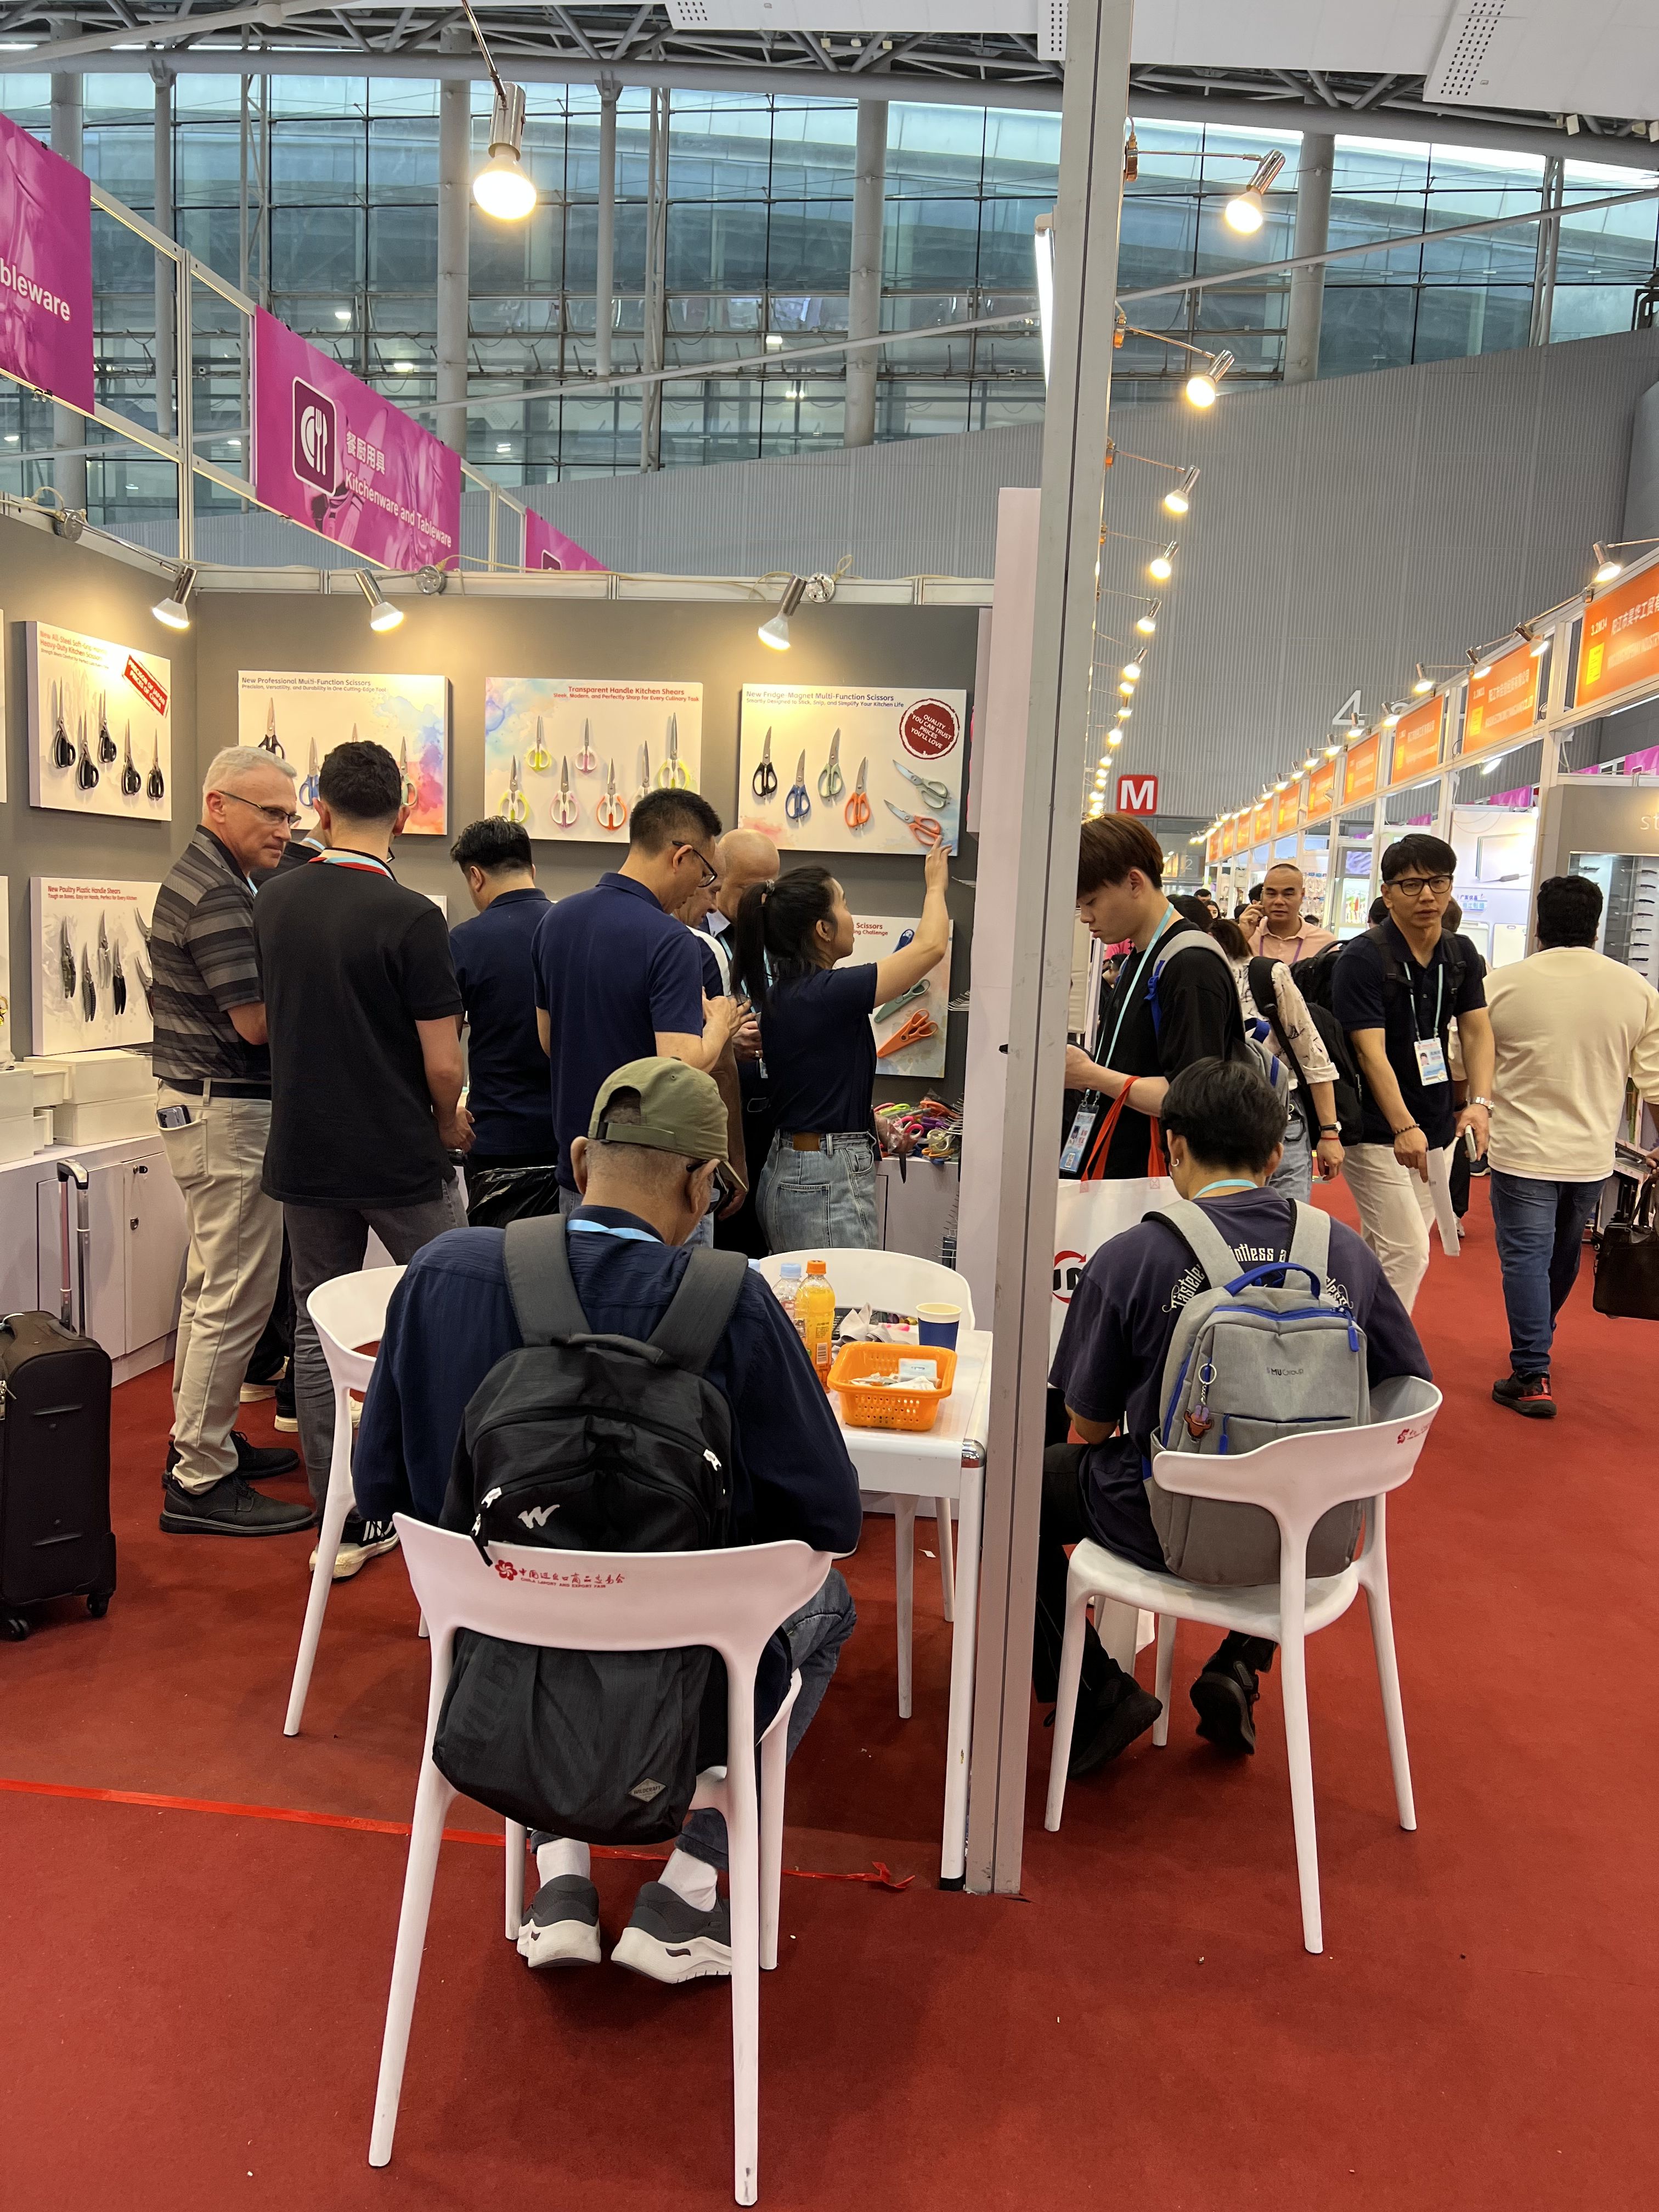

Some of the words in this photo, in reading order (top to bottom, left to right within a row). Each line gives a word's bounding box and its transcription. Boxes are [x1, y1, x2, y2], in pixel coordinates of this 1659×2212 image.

[0, 257, 70, 321] bleware
[346, 431, 385, 475] 餐厨用具
[345, 469, 399, 516] Kitchenware
[400, 507, 415, 526] and
[416, 512, 452, 548] Tableware
[1332, 690, 1365, 725] 4
[912, 714, 924, 724] YOU
[923, 721, 935, 731] CAN
[935, 727, 952, 740] TRUST
[919, 725, 938, 739] PRICES
[923, 714, 946, 730] QUALITY
[911, 727, 927, 741] YOU'LL
[928, 738, 943, 749] LOVE
[1120, 780, 1154, 809] M
[1228, 1243, 1274, 1262] ntless
[519, 1568, 625, 1584] 中国进出口商品交易会
[634, 1786, 661, 1795] WILDCRAFT
